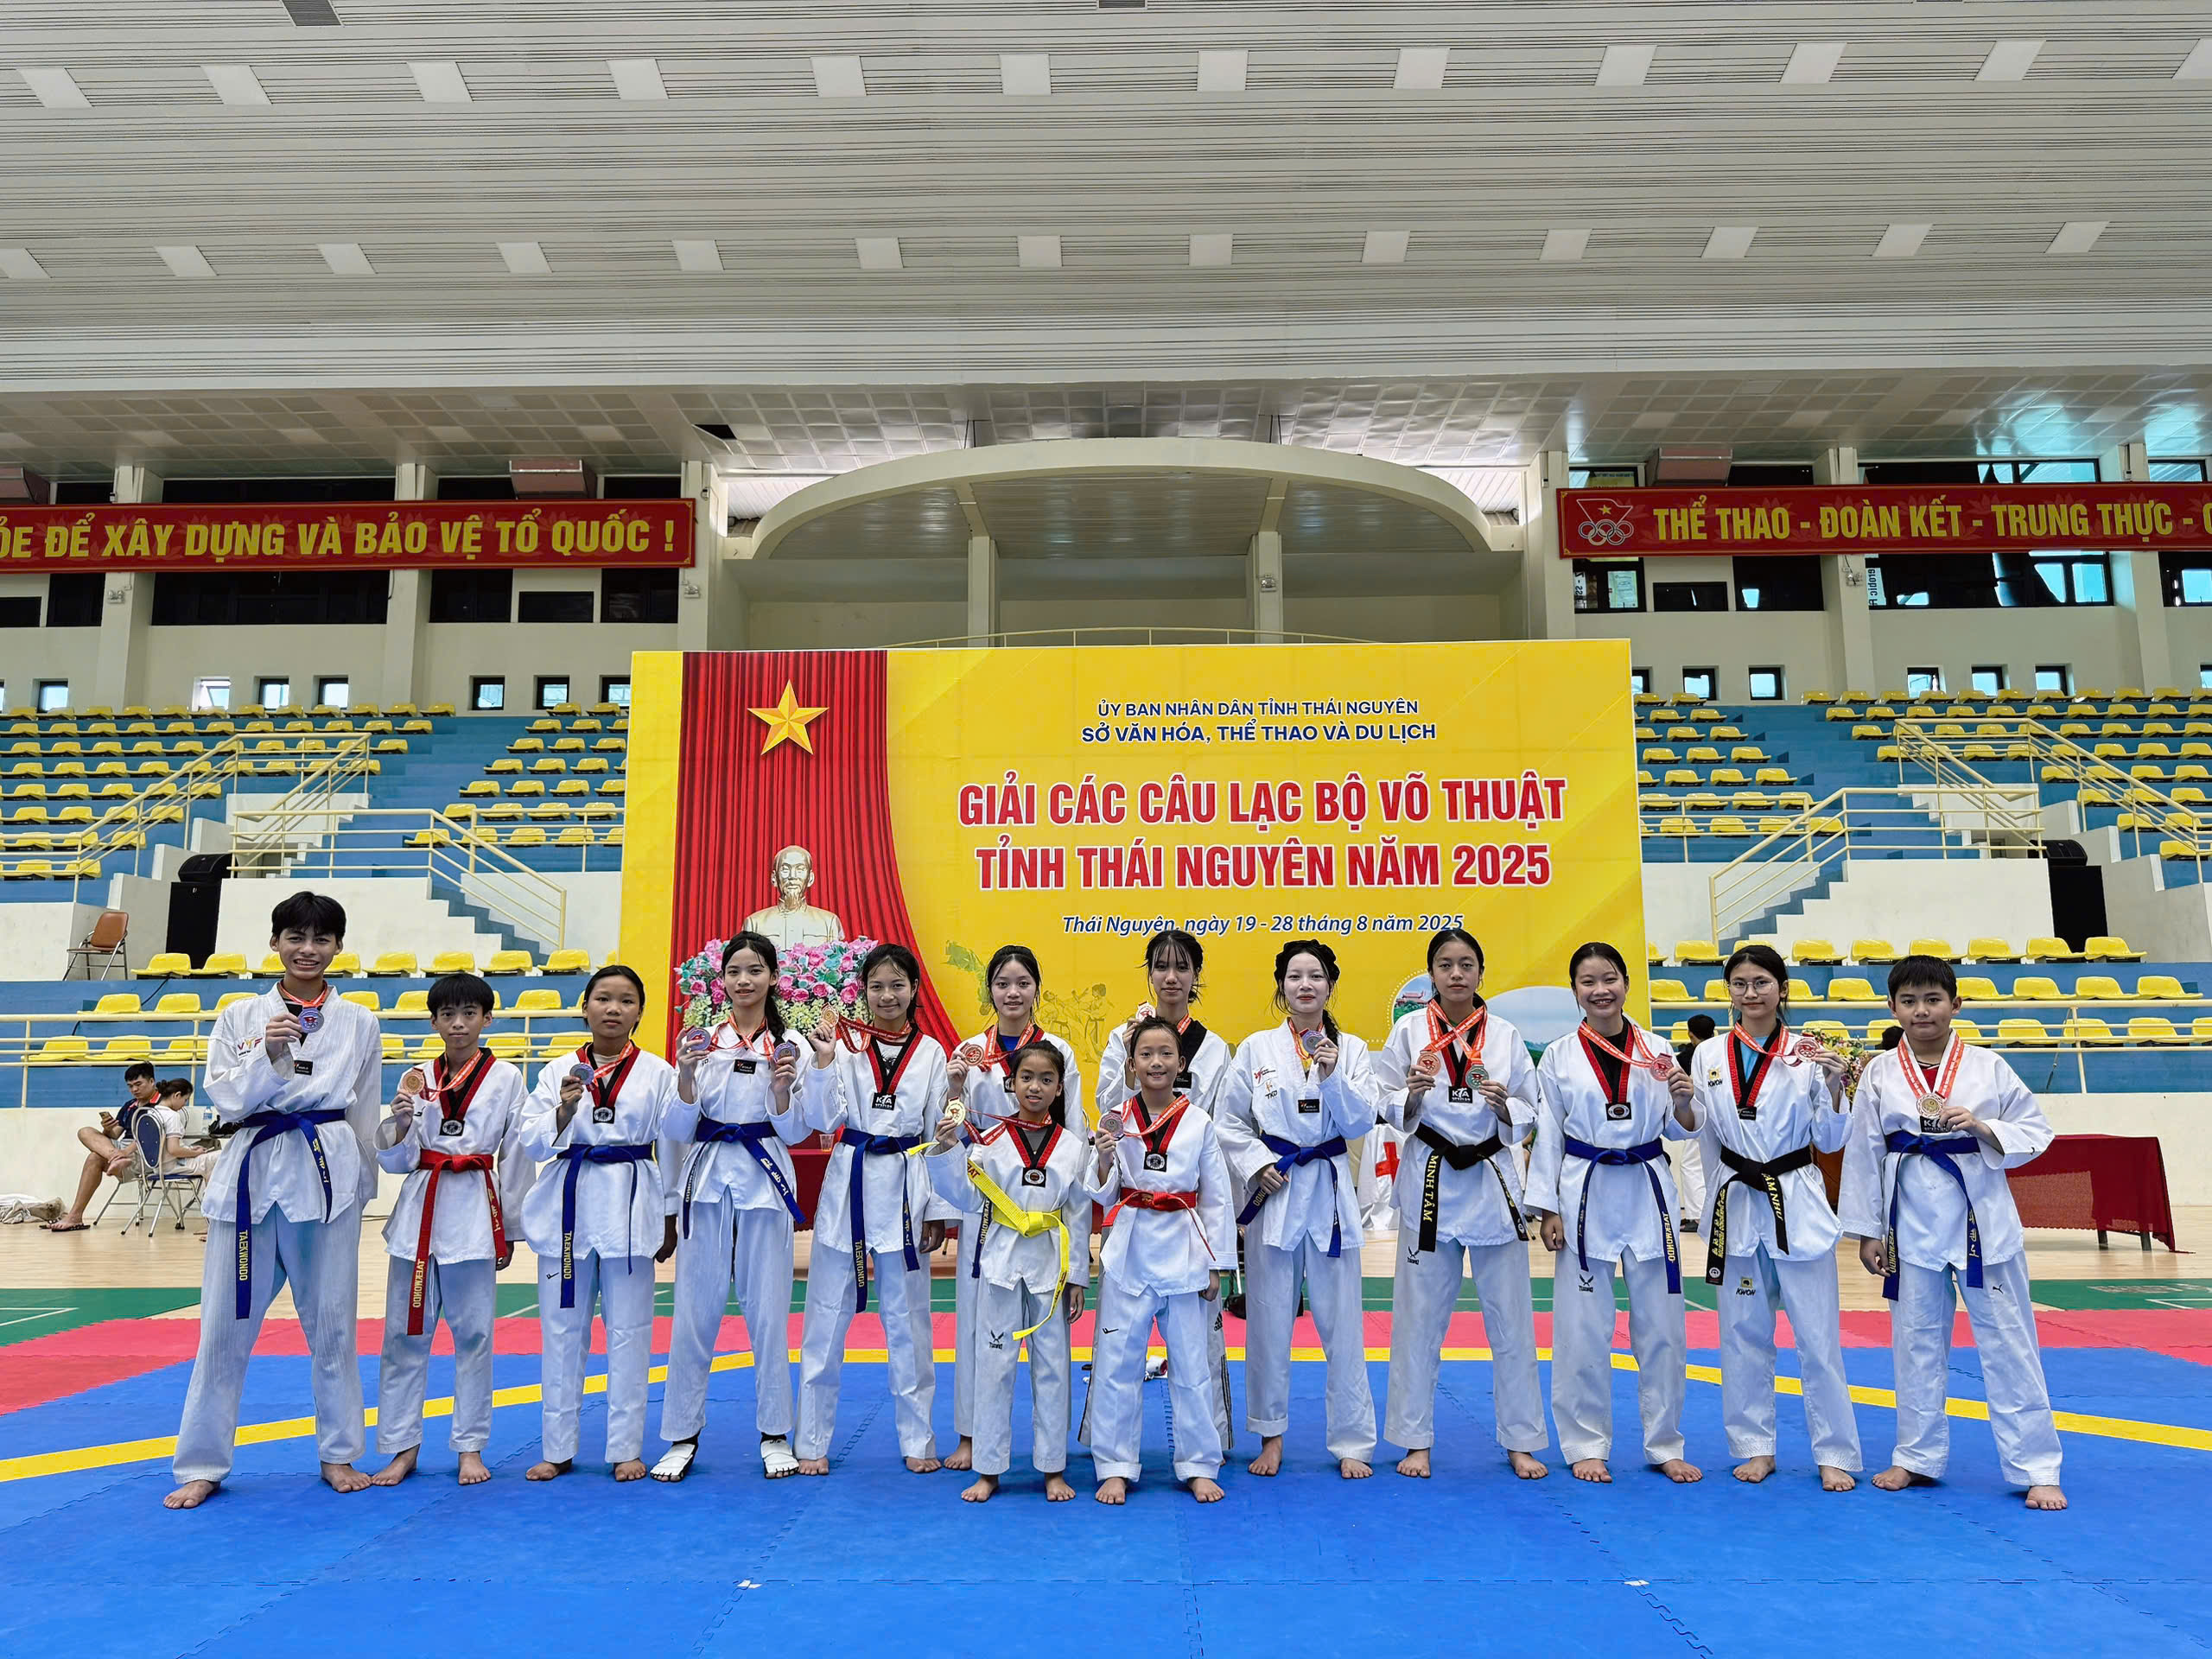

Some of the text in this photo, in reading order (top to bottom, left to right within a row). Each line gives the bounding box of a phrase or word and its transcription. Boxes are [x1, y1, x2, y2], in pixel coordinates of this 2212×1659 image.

[44, 512, 95, 558] ĐỂ
[101, 518, 175, 556] XÂY
[184, 520, 285, 563] DỰNG
[297, 516, 342, 555] VÀ
[355, 512, 428, 554] BẢO
[440, 514, 483, 560] VỆ
[495, 508, 542, 553] TỔ
[551, 508, 650, 556] QUỐC
[664, 520, 675, 551] !
[1653, 494, 1707, 540] THỂ
[1715, 507, 1791, 540] THAO
[1819, 499, 1901, 538] ĐOÀN
[1909, 494, 1961, 537] KẾT
[1991, 504, 2090, 537] TRUNG
[2097, 499, 2173, 543] THỰC
[1082, 718, 1435, 744] SỞ VĂN HÓA, THỂ THAO VÀ DU LỊCH
[1098, 698, 1418, 716] ỦY BAN NHÂN DÂN TỈNH THÁI NGUYÊN
[959, 771, 1566, 831] GIẢI CÁC CÂU LẠC BỘ VÕ THUẬT
[976, 835, 1551, 888] TỈNH THÁI NGUYÊN NĂM 2025
[1064, 916, 1102, 932] Thái
[1185, 915, 1230, 936] ngày
[1236, 916, 1256, 931] 19
[1271, 915, 1294, 931] 28
[1298, 914, 1352, 935] tháng
[1356, 915, 1368, 931] 8
[1372, 914, 1413, 931] năm
[1417, 914, 1464, 931] 2025
[1423, 1154, 1440, 1222] MINH TÂM
[238, 1230, 248, 1281] TAEKWONDO
[563, 1230, 572, 1280] TAEKWONDO
[855, 1239, 865, 1287] TAEKWONDO
[1736, 1287, 1756, 1296] KWON
